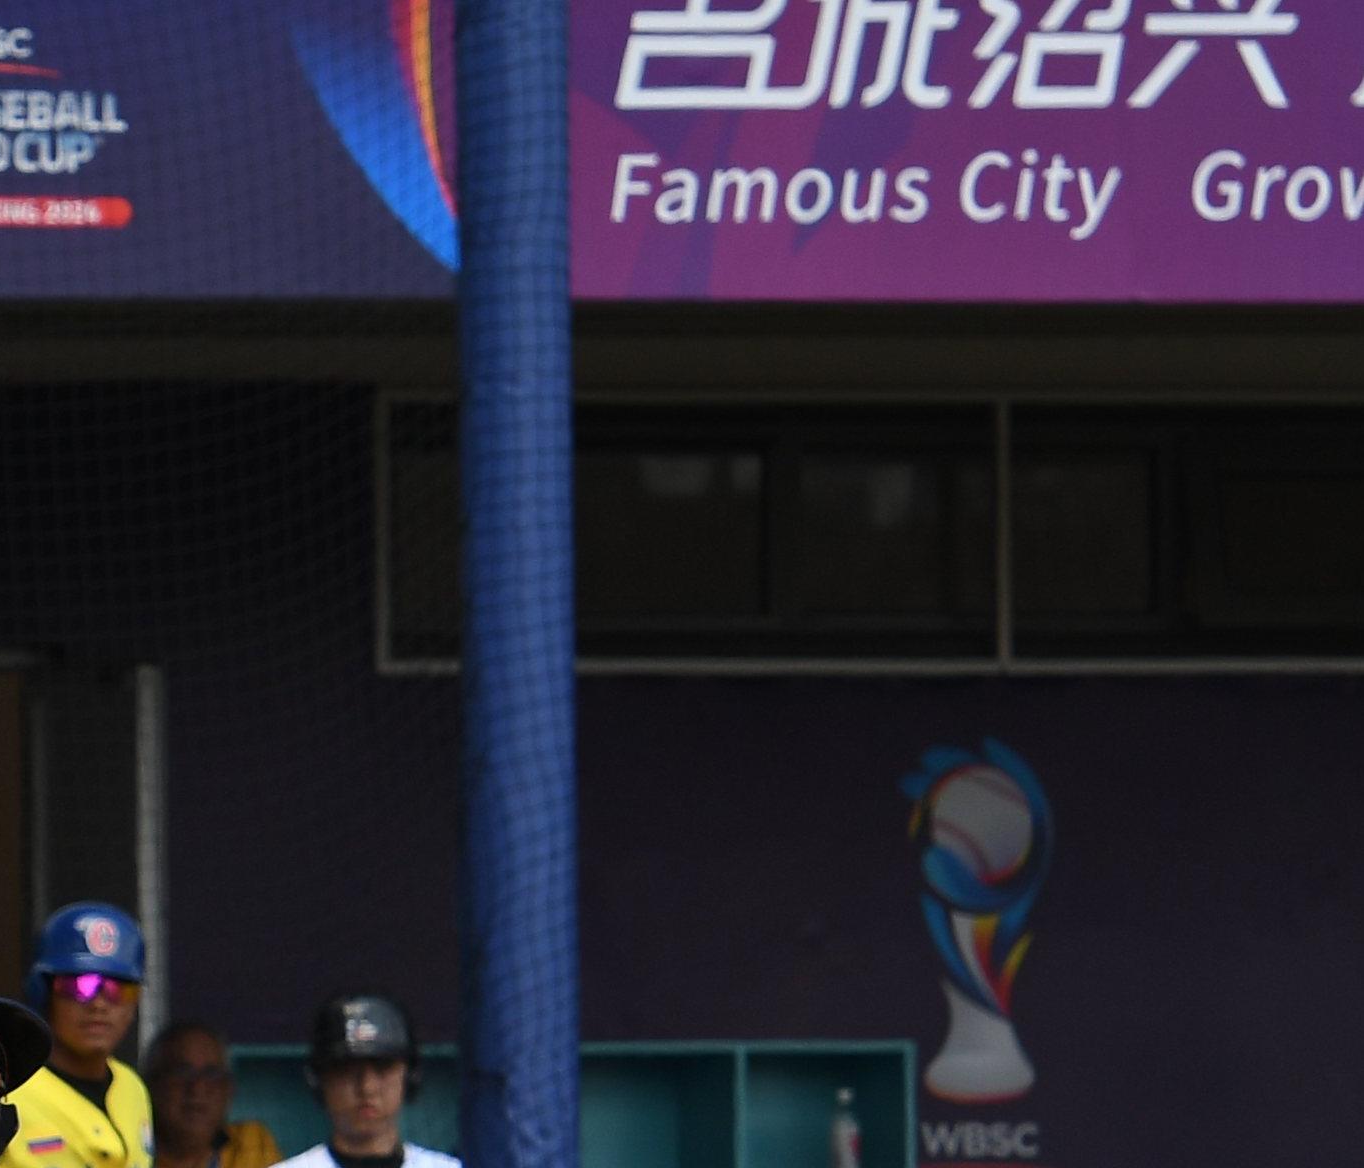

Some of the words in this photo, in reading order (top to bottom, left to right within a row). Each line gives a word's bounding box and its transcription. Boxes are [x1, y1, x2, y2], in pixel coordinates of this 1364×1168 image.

[13, 130, 95, 174] CUP
[610, 153, 930, 224] Famous
[959, 149, 1121, 240] City
[922, 1122, 1040, 1158] WBSC
